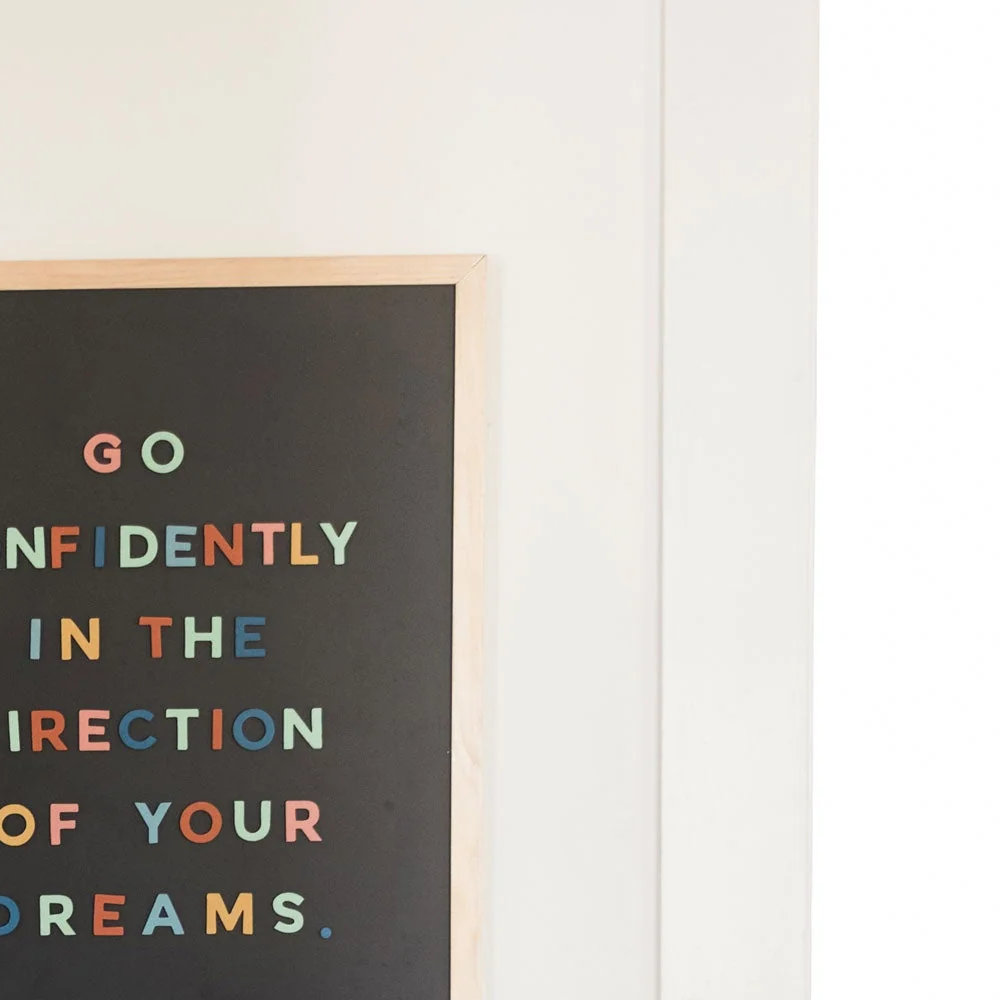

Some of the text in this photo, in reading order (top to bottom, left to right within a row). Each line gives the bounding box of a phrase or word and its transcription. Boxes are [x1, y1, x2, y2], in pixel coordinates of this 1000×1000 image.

[82, 430, 185, 474] GO
[29, 615, 266, 661] IN THE
[135, 799, 323, 844] YOUR
